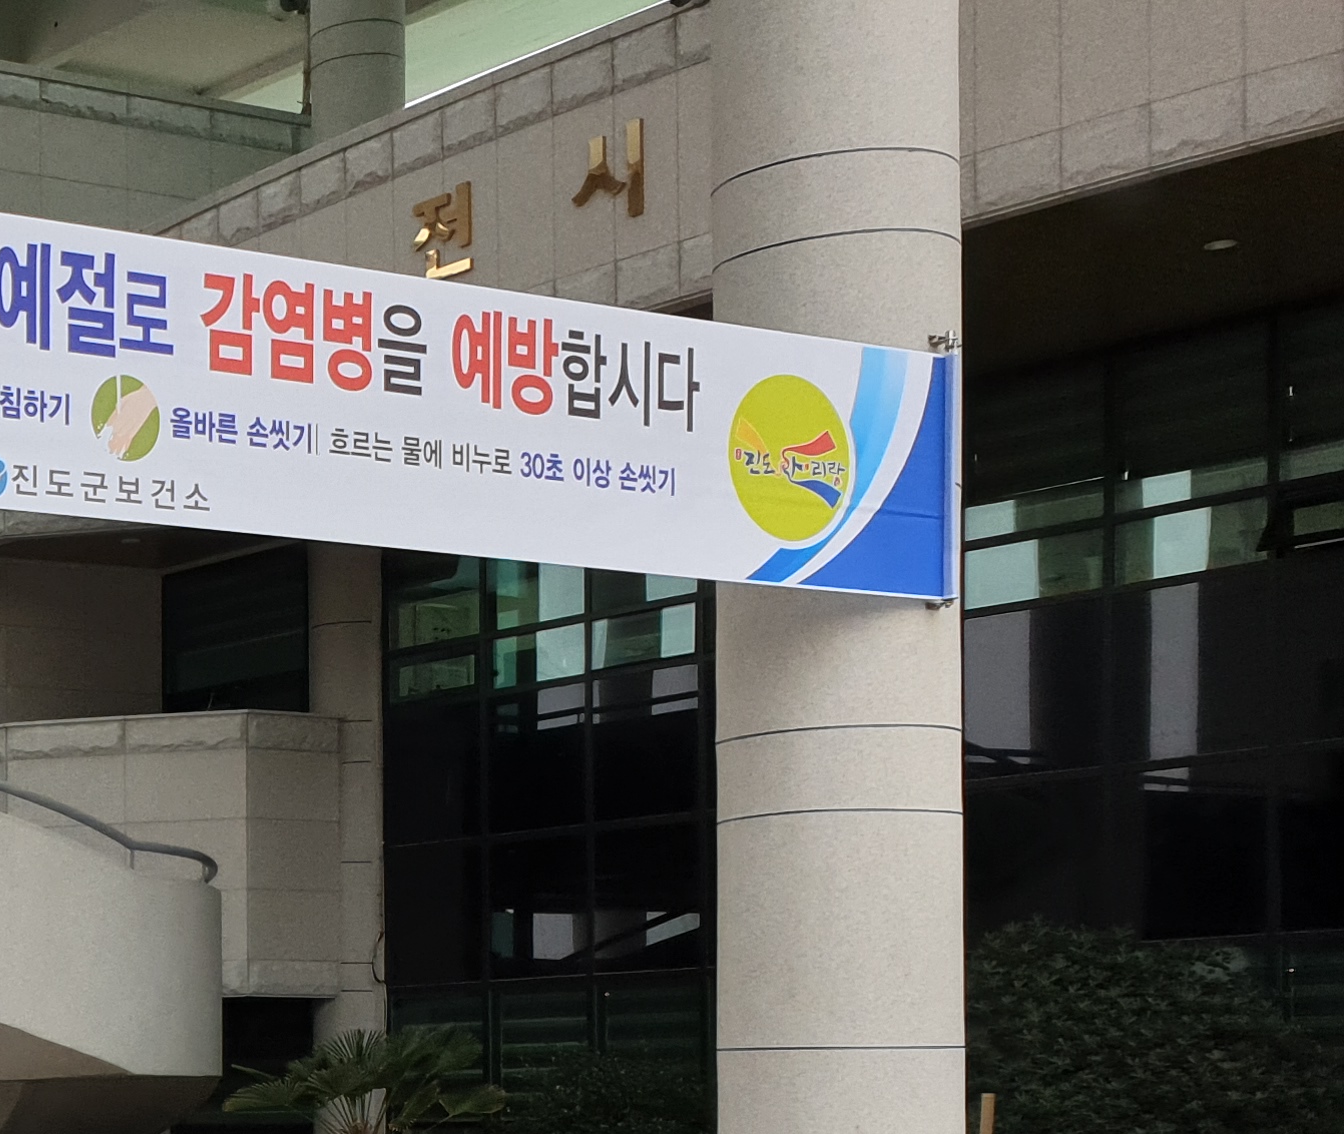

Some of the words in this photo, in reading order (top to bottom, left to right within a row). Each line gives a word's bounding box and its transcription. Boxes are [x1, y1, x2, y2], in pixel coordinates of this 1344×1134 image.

[199, 271, 429, 396] 감염병을
[451, 309, 701, 433] 예방합시다
[11, 462, 211, 512] 진도군보건소
[169, 406, 240, 446] 올바른
[328, 428, 394, 464] 흐르는
[400, 436, 443, 470] 물에
[451, 442, 513, 476] 비누로
[519, 450, 566, 483] 30초
[572, 456, 613, 490] 이상
[617, 461, 678, 497] 손씻기
